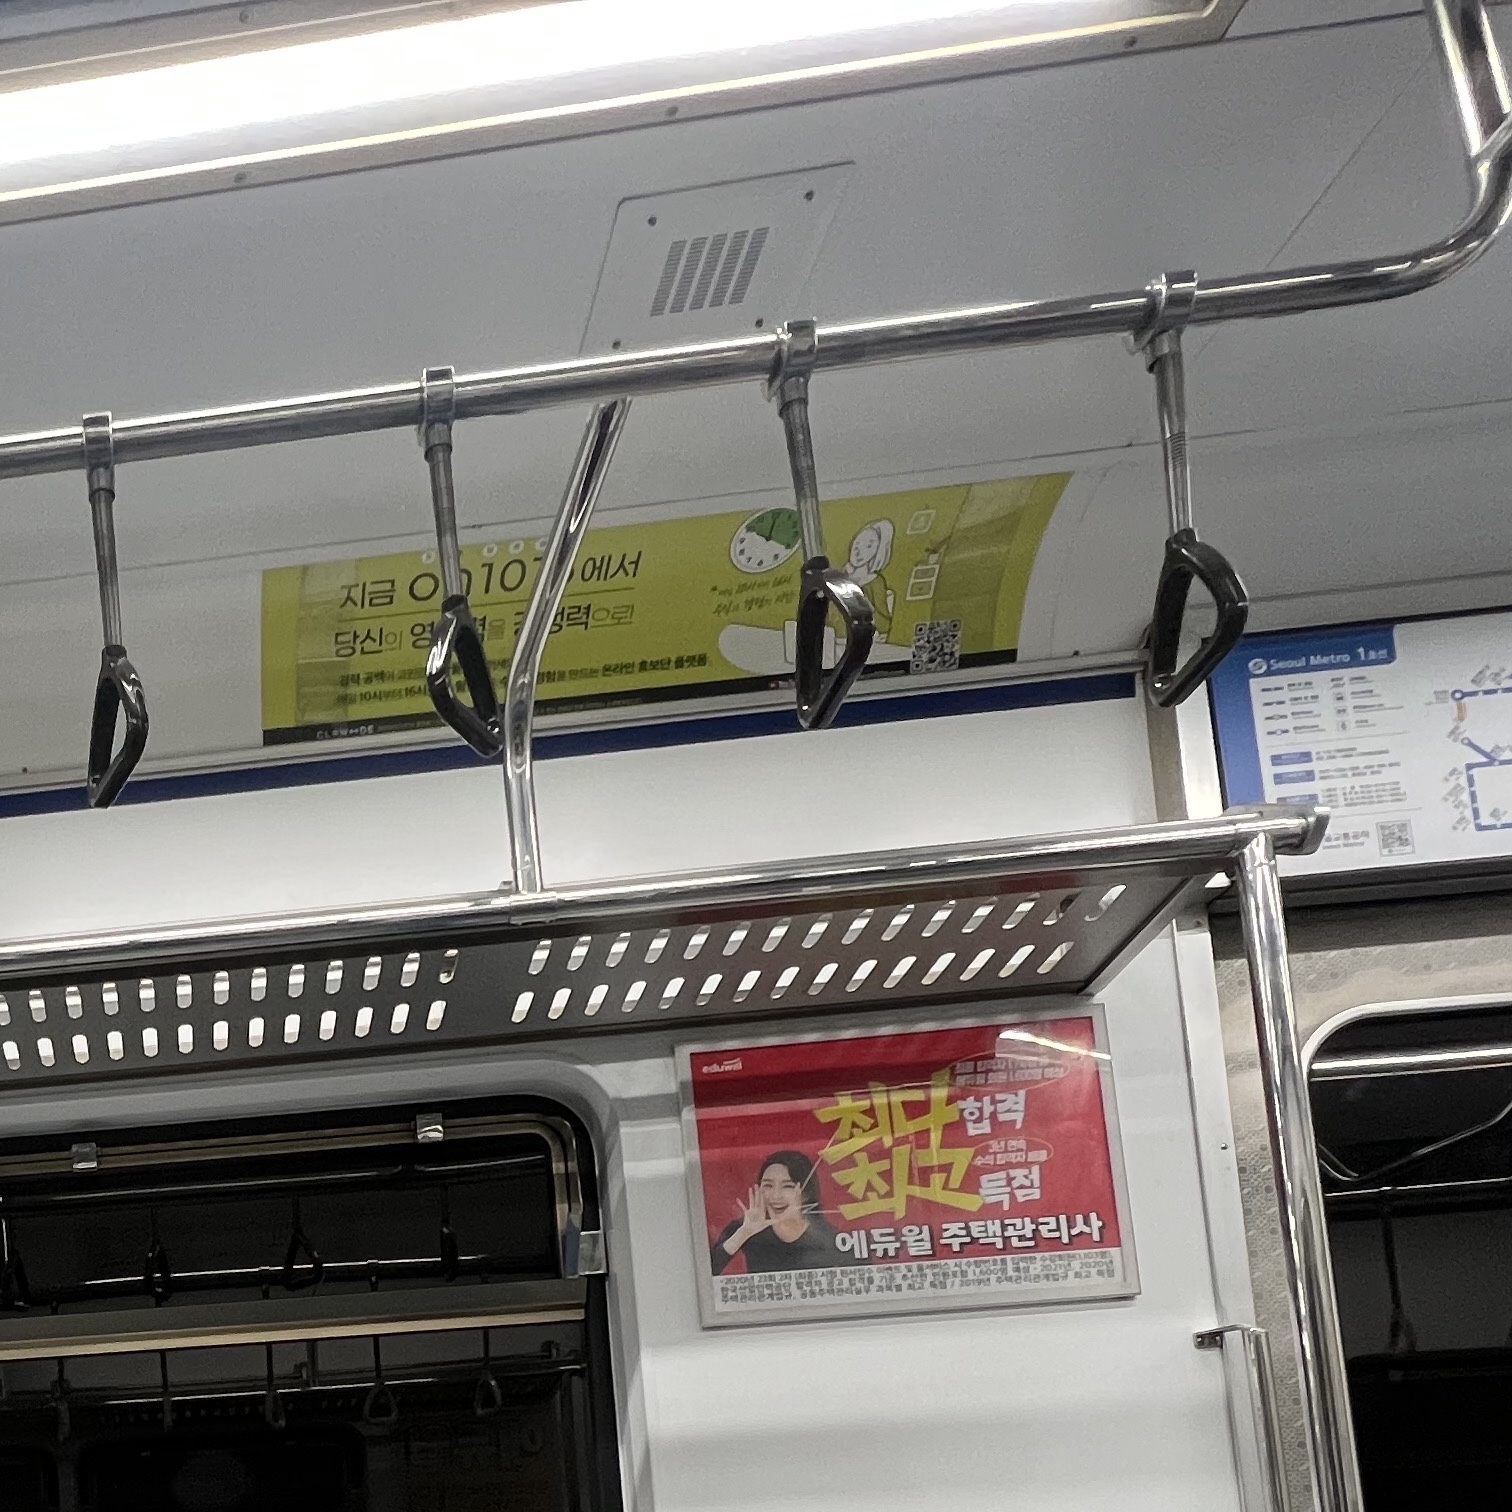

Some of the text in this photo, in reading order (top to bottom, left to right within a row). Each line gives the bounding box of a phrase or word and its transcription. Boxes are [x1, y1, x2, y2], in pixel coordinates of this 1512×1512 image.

[339, 578, 396, 609] 지금
[335, 627, 403, 657] 당신의
[410, 615, 504, 649] 영을
[602, 662, 635, 677] 온라인
[674, 653, 707, 669] 플랫폼
[1270, 656, 1306, 670] Seoul
[1310, 654, 1350, 666] Metro
[814, 1066, 961, 1163] 최다
[957, 1089, 1026, 1136] 합격
[832, 1144, 984, 1220] 최고
[978, 1166, 1042, 1211] 득점
[835, 1212, 1104, 1259] 에듀윌 주택관리사
